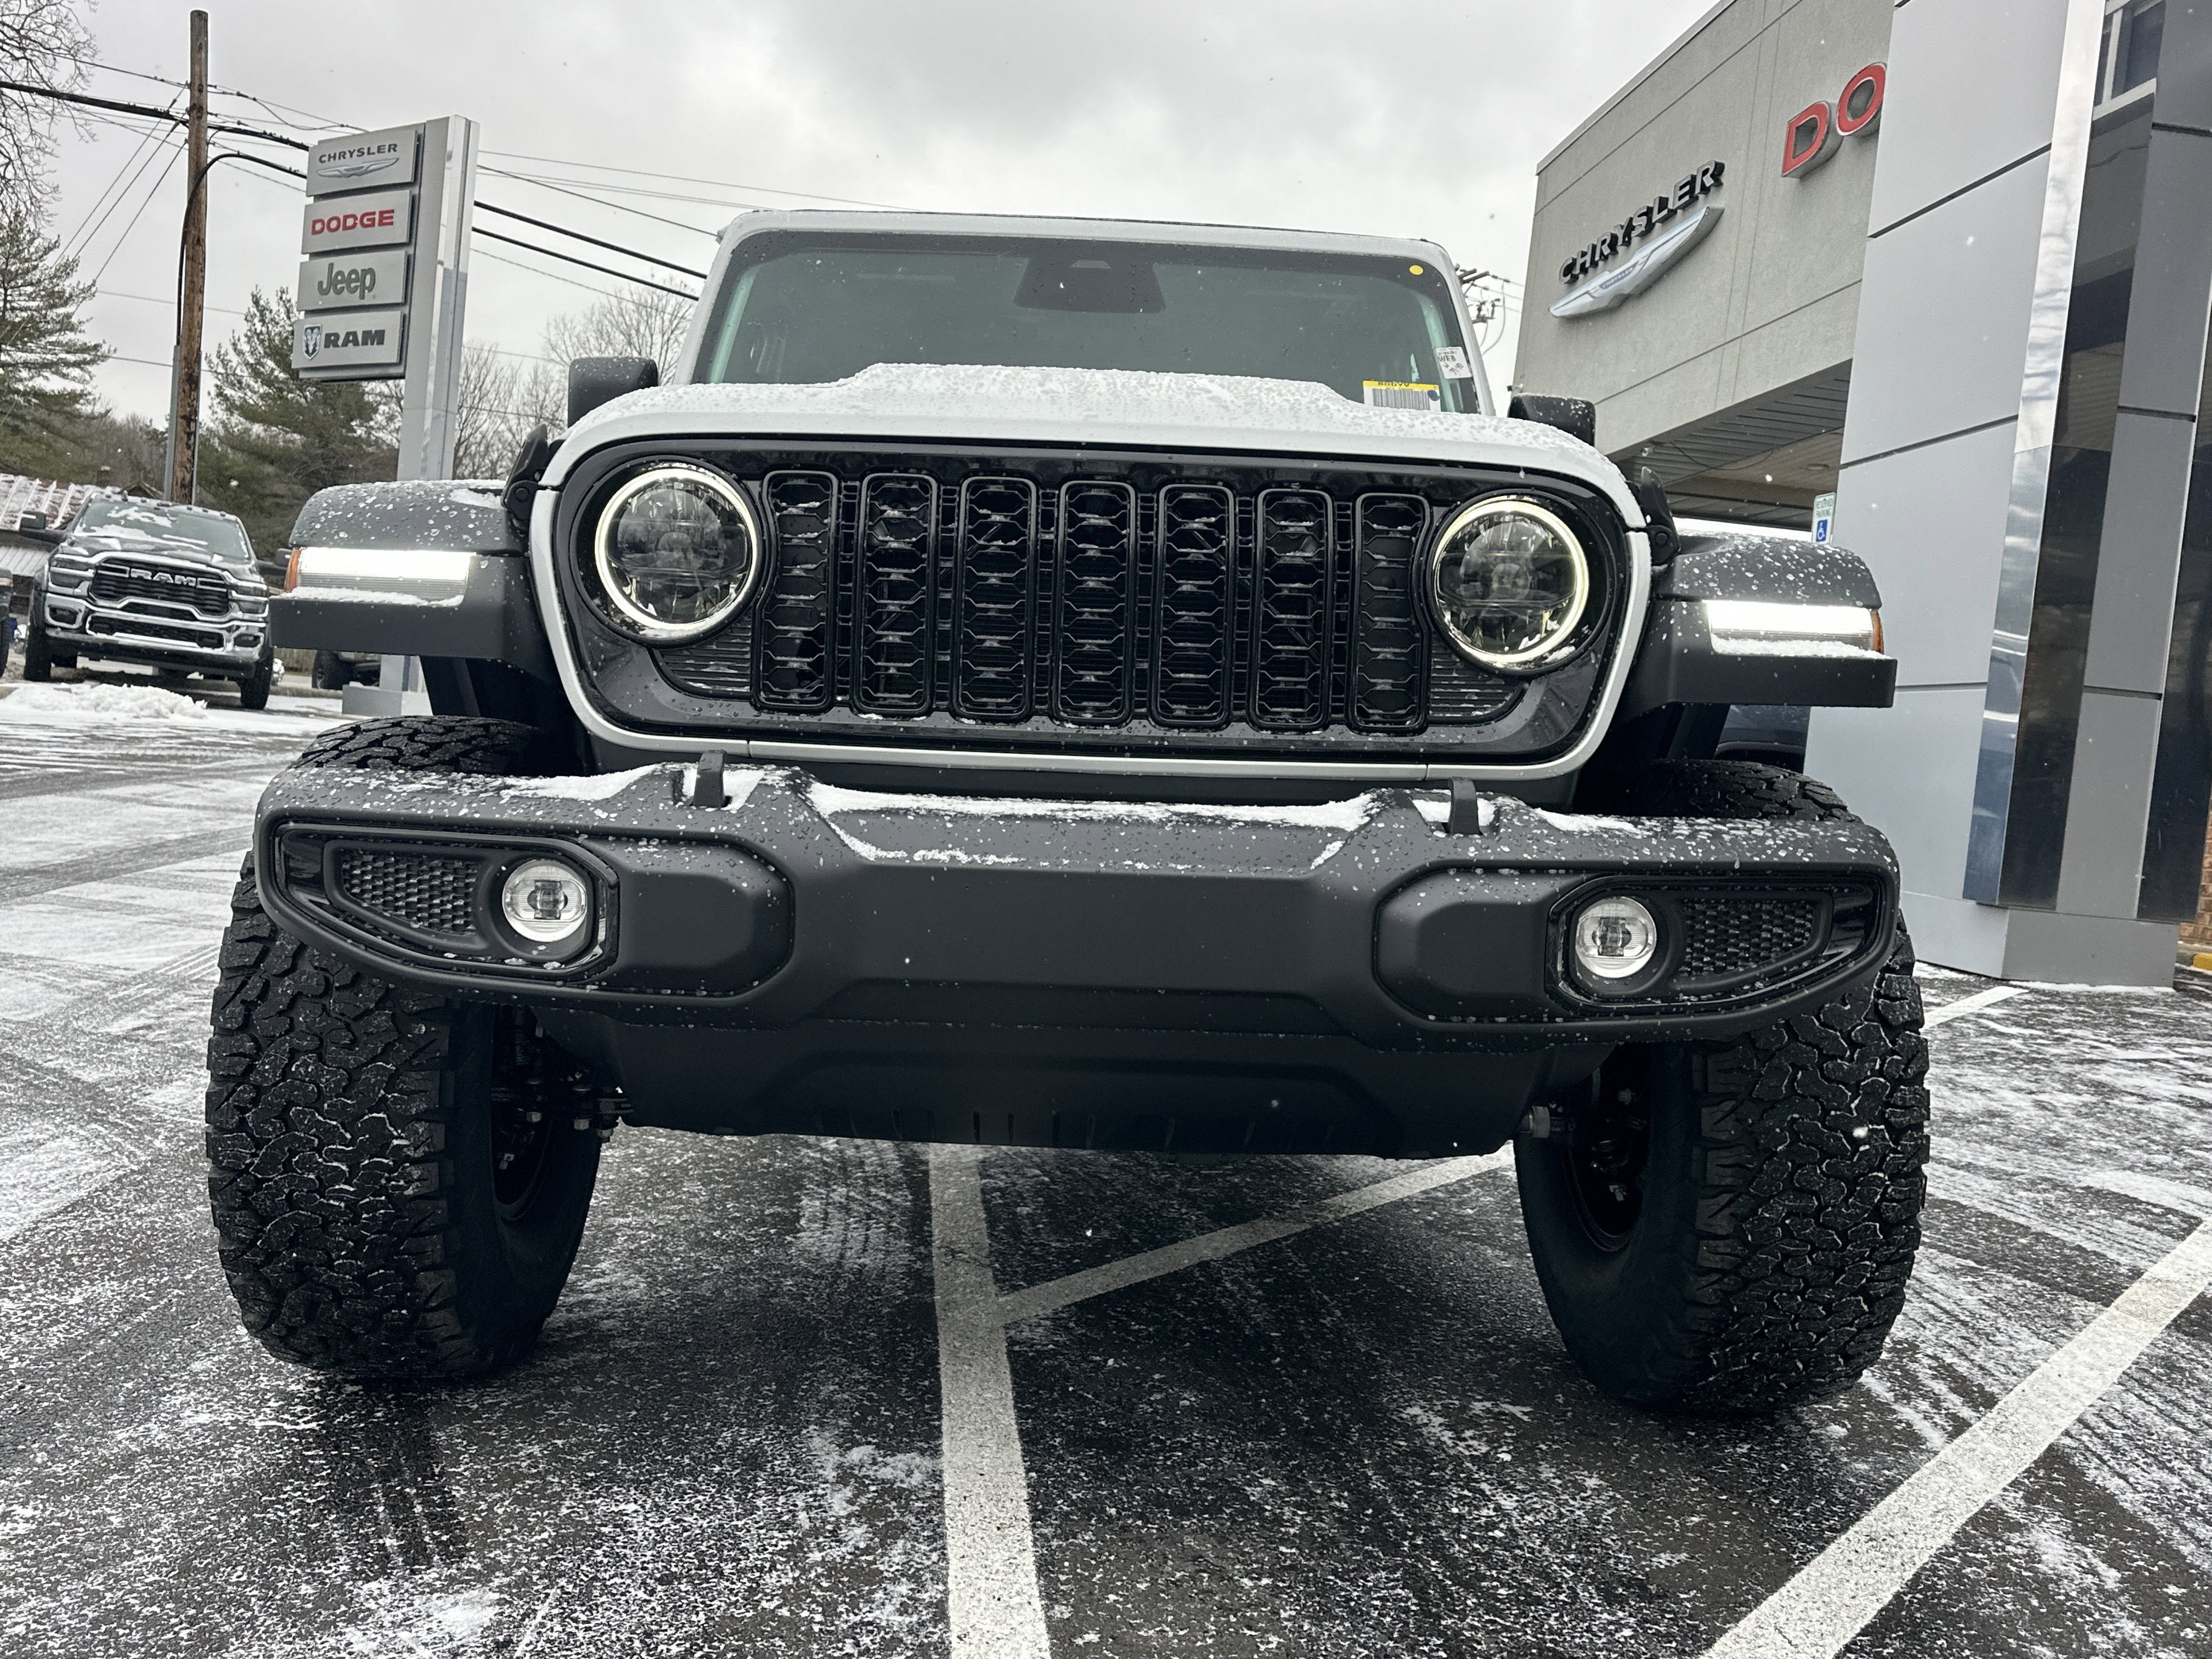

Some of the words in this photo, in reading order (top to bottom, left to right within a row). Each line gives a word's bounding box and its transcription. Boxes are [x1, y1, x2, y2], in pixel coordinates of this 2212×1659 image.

[319, 143, 398, 163] CHRYSLER
[311, 209, 394, 235] DODGE
[1559, 160, 1725, 284] CHRYSLER
[318, 263, 376, 300] Jeep
[324, 329, 386, 348] RAM
[131, 568, 196, 586] RAM
